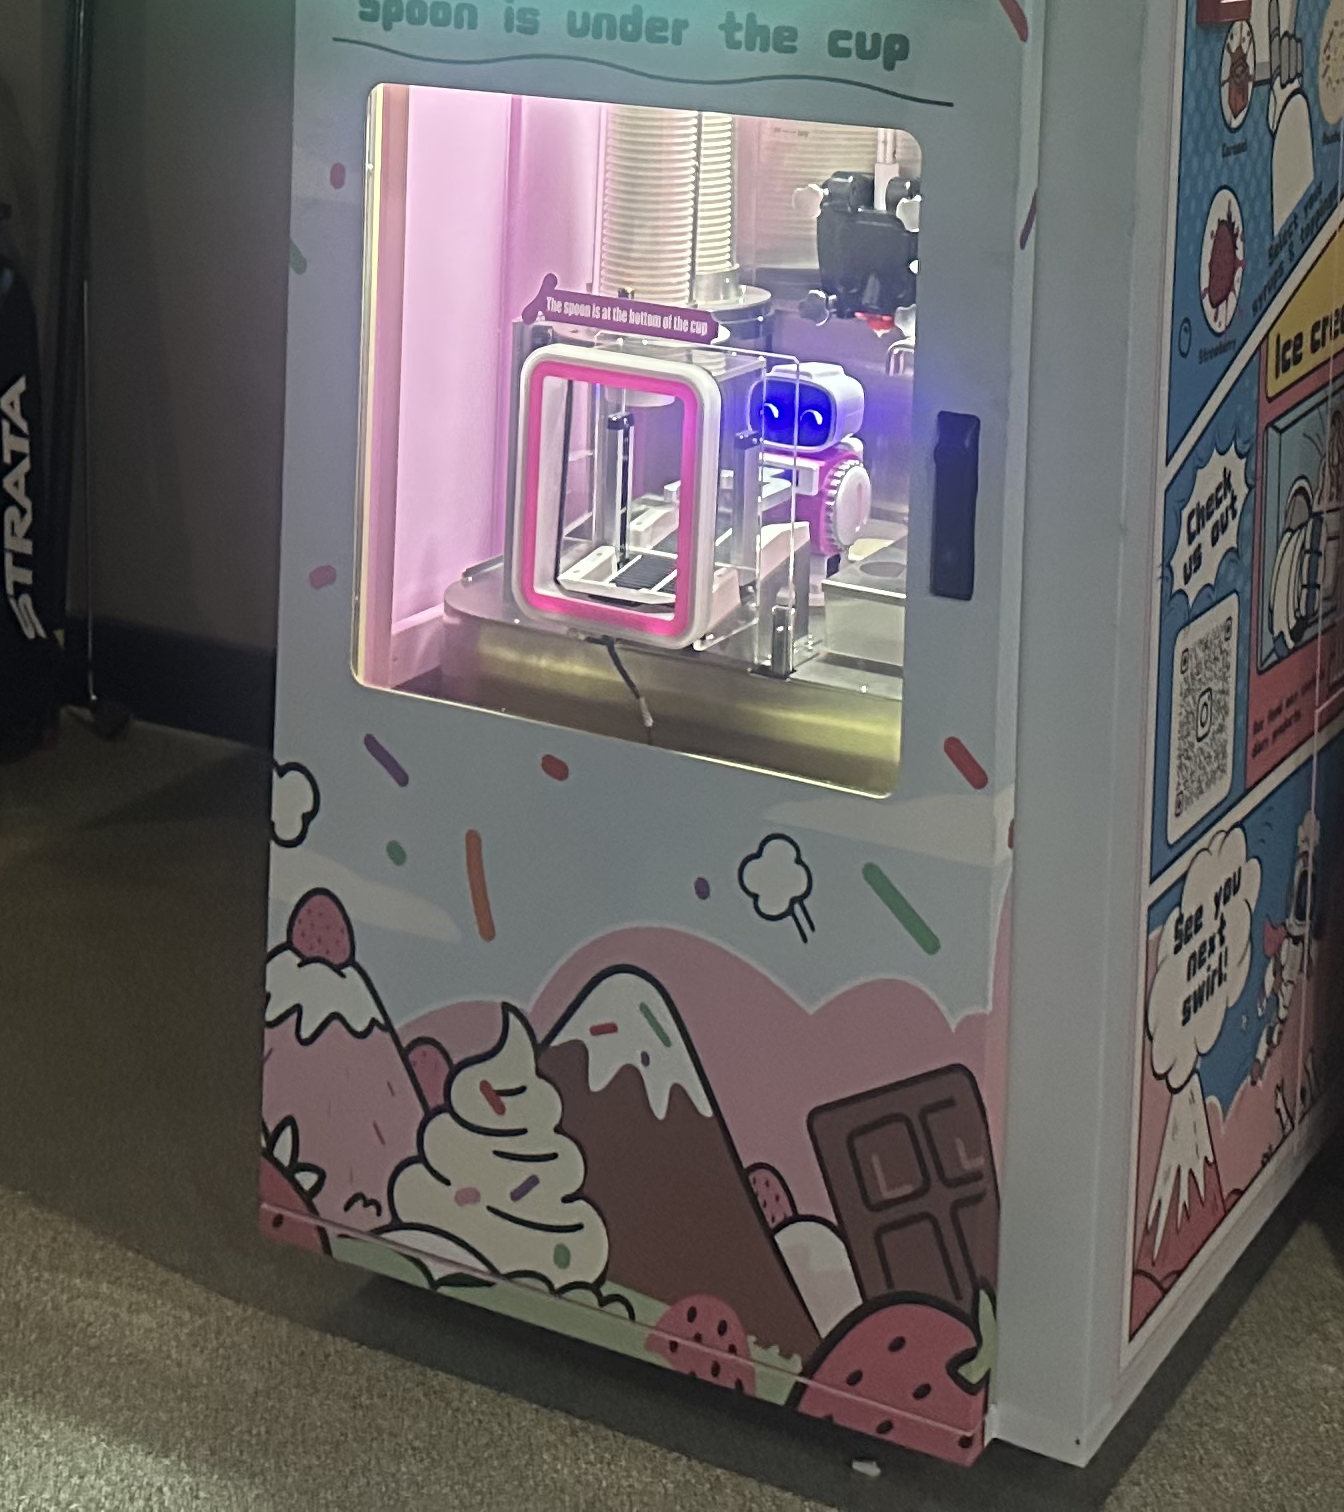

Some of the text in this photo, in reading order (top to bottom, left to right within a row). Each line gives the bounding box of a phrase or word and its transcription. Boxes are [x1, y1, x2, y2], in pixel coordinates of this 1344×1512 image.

[567, 2, 690, 48] under
[718, 10, 799, 54] the
[827, 25, 911, 71] cup
[546, 296, 708, 337] The spoon is at the bottom of the cup
[1274, 331, 1304, 381] Ice
[0, 374, 47, 641] STRATA
[1183, 492, 1238, 587] us out
[1186, 466, 1233, 547] Check
[1173, 865, 1242, 955] See you
[1186, 911, 1227, 987] next
[1181, 950, 1229, 1028] swirl!
